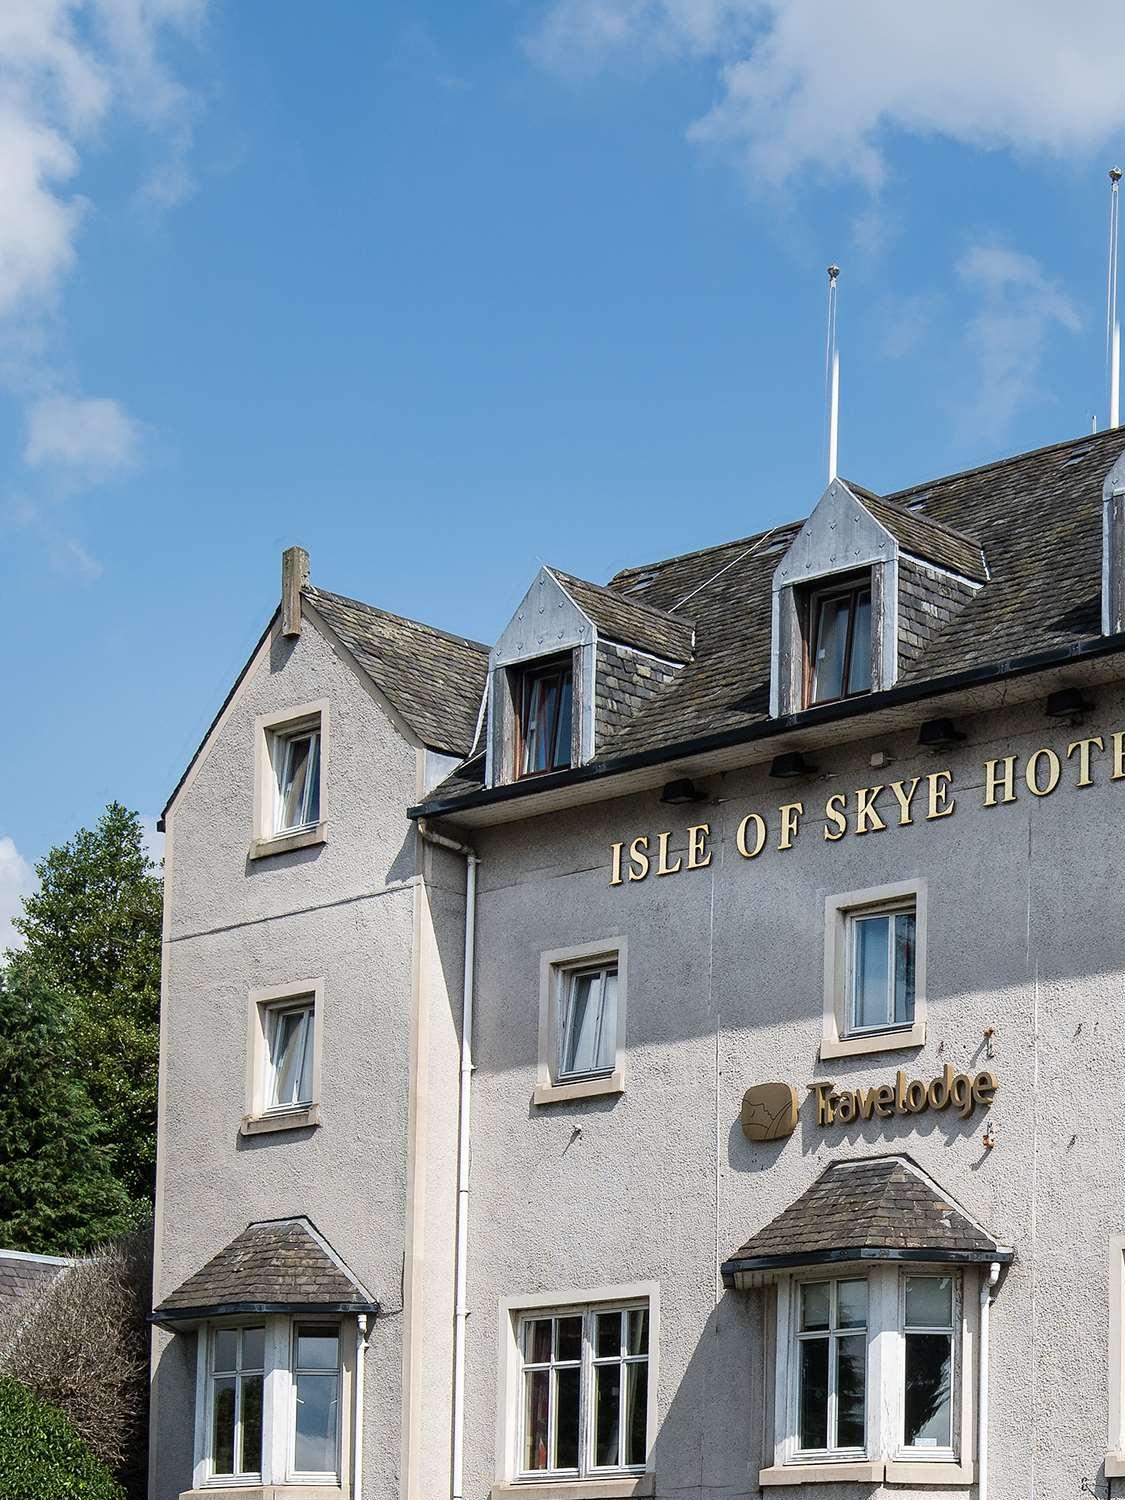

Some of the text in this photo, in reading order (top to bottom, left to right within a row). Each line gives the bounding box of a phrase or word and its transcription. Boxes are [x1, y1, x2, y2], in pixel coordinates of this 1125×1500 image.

[608, 823, 712, 887] ISLE
[735, 802, 804, 859] OF
[823, 770, 955, 842] SKYE
[806, 1063, 998, 1126] Travelodge
